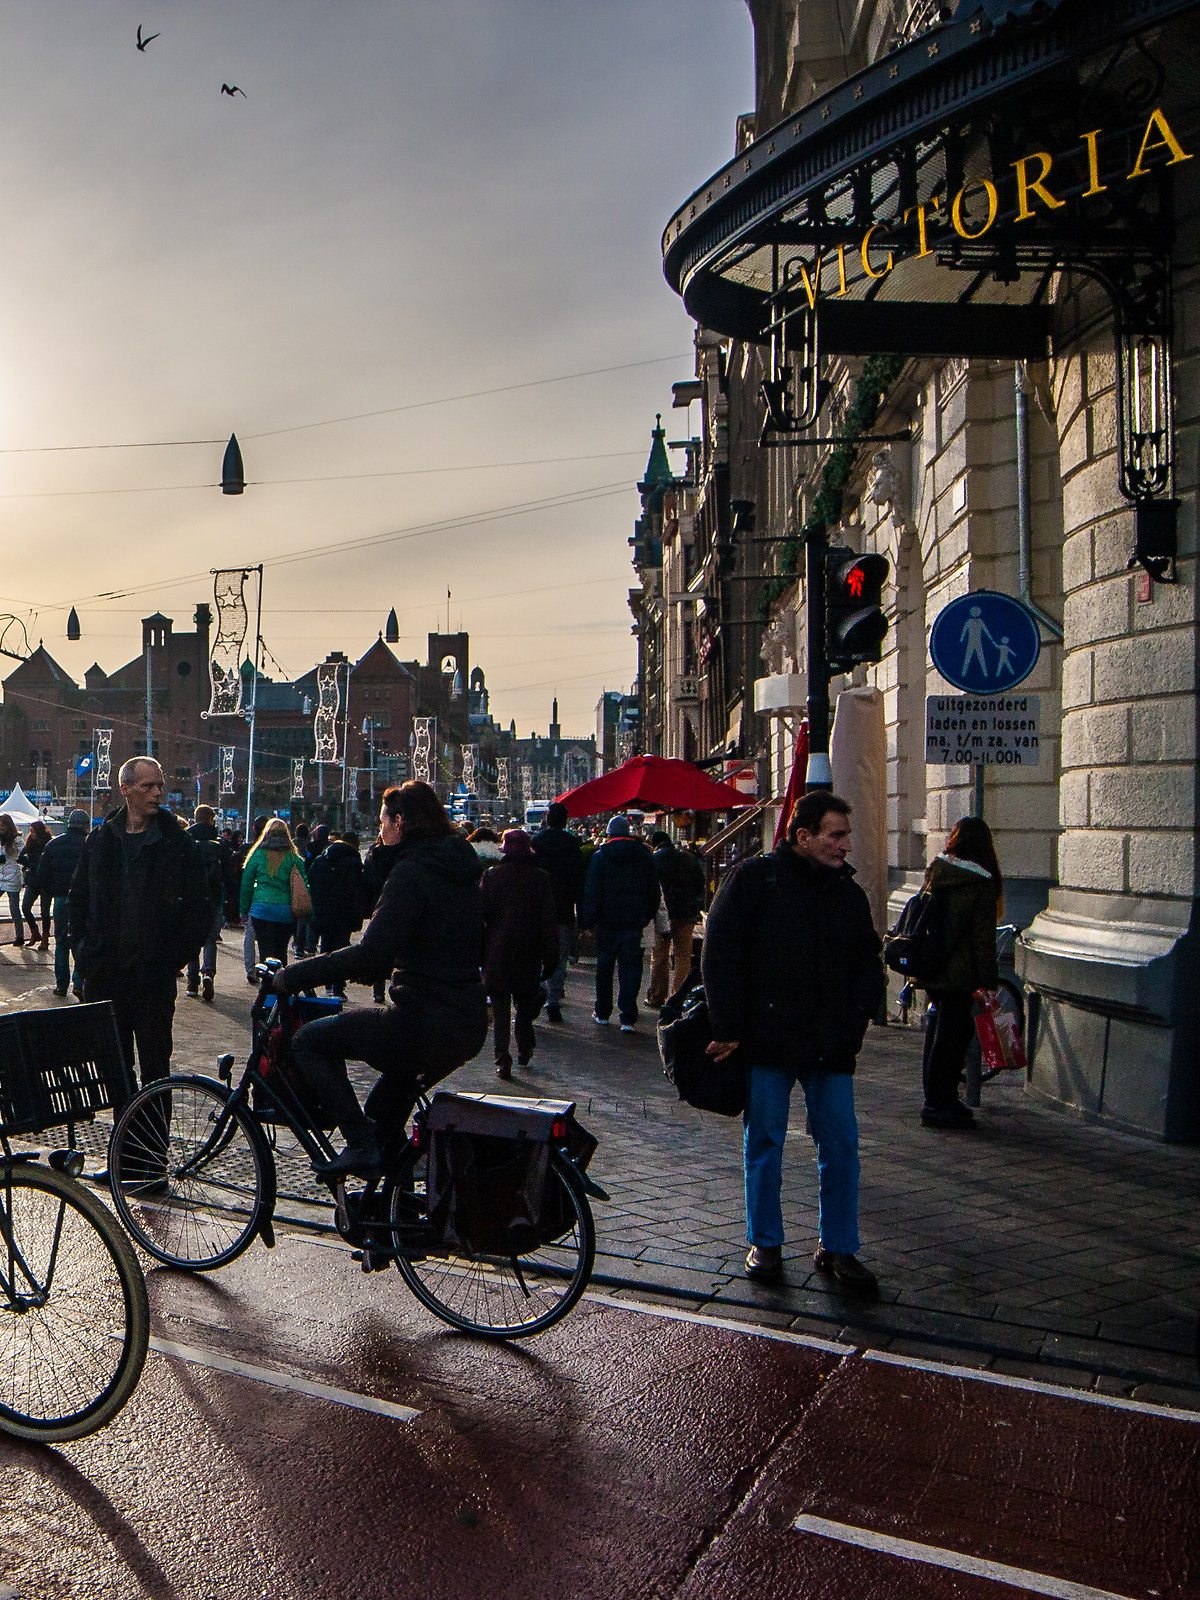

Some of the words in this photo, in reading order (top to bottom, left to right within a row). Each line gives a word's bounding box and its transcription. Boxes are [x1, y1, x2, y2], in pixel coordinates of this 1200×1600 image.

[800, 108, 1194, 310] VICTORIA
[937, 698, 1027, 714] uitgezonderd
[930, 716, 966, 730] laden
[972, 720, 987, 730] en
[993, 717, 1036, 730] lossen
[927, 735, 950, 747] ma.
[957, 732, 983, 747] t/m
[988, 735, 1007, 747] za.
[1014, 735, 1039, 747] van
